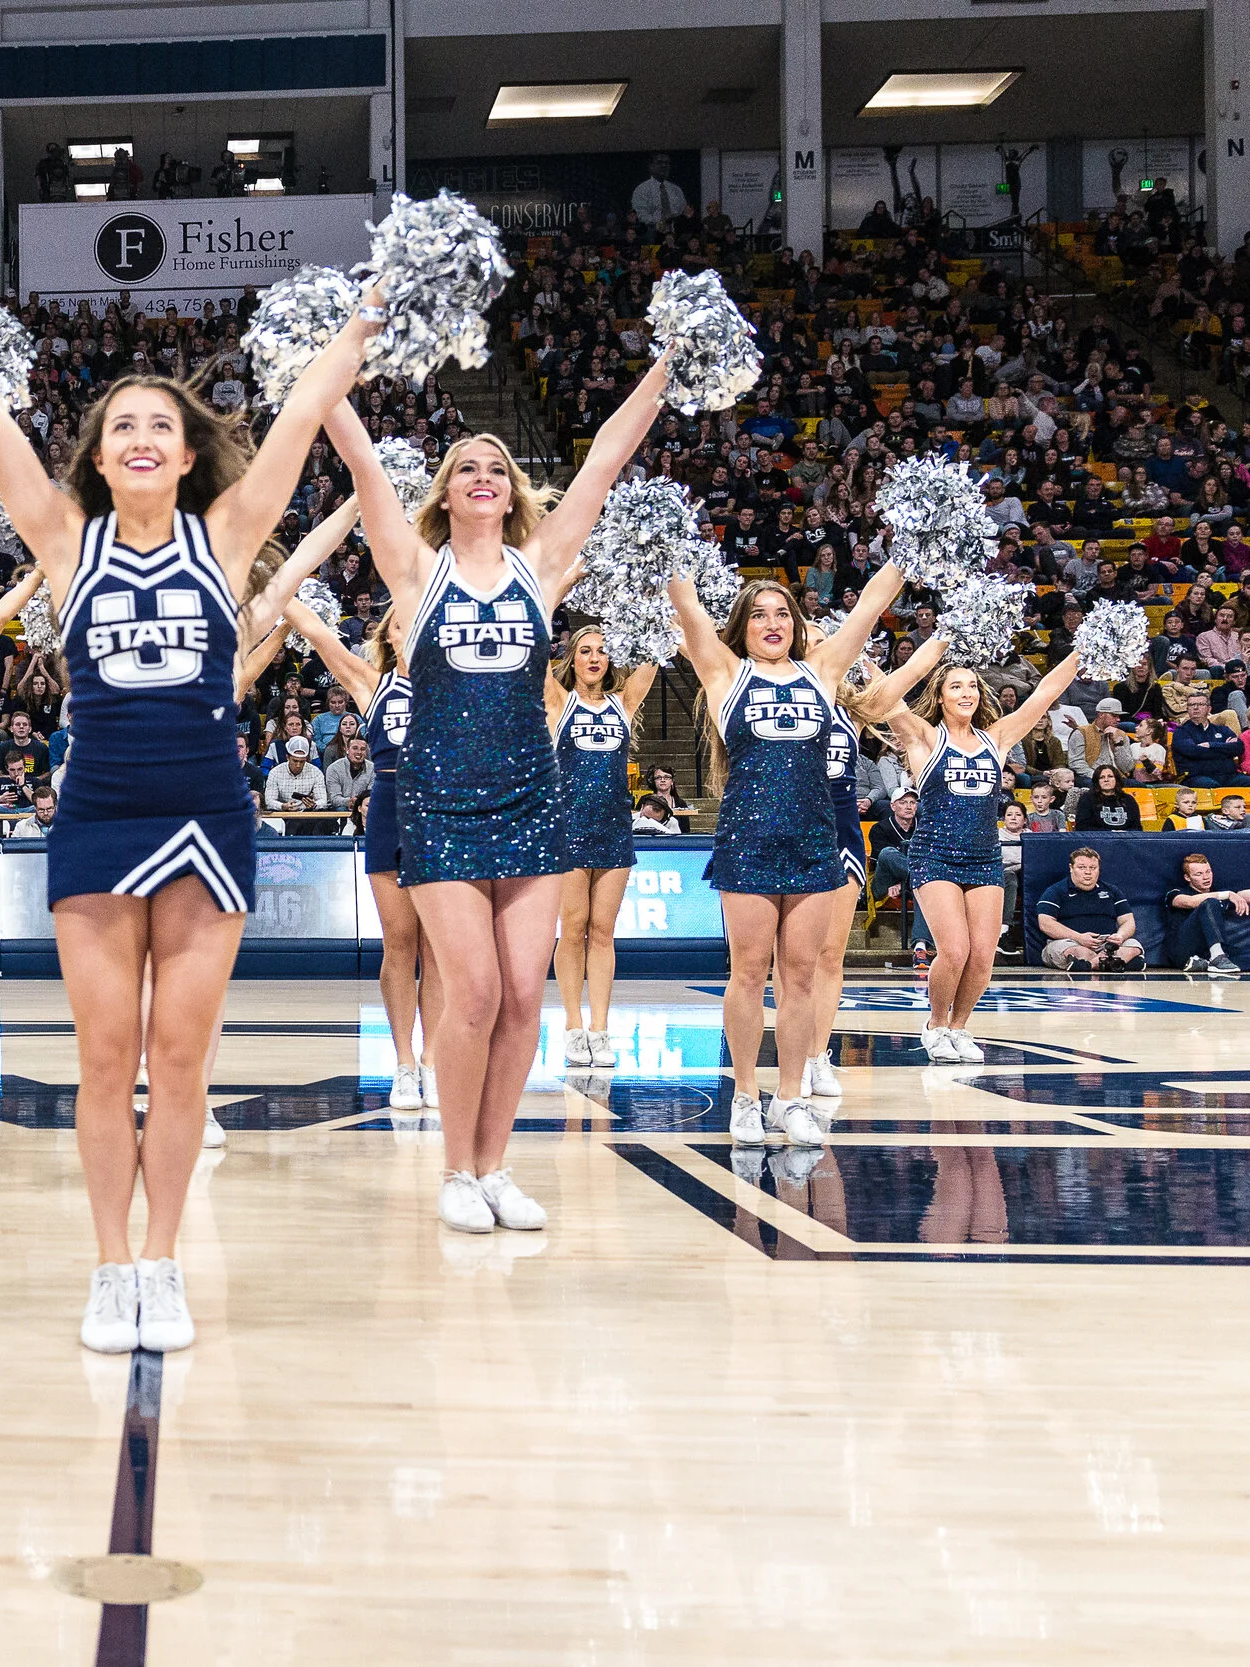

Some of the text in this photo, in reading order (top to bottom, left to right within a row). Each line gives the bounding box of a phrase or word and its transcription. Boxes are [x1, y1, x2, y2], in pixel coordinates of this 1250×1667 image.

[1227, 137, 1245, 157] N
[795, 150, 814, 169] M
[383, 164, 393, 182] L
[408, 164, 540, 194] AGGIES
[490, 201, 591, 230] CONSERVIC
[177, 217, 295, 254] Fisher
[116, 228, 145, 268] F
[172, 253, 301, 272] Home Furnishings
[40, 298, 66, 307] 25
[68, 297, 97, 307] Noth
[85, 618, 209, 661] STATE
[438, 621, 536, 648] STATE
[744, 701, 824, 723] STATE
[569, 723, 624, 739] STATE
[943, 767, 998, 784] STATE
[255, 890, 302, 926] 46
